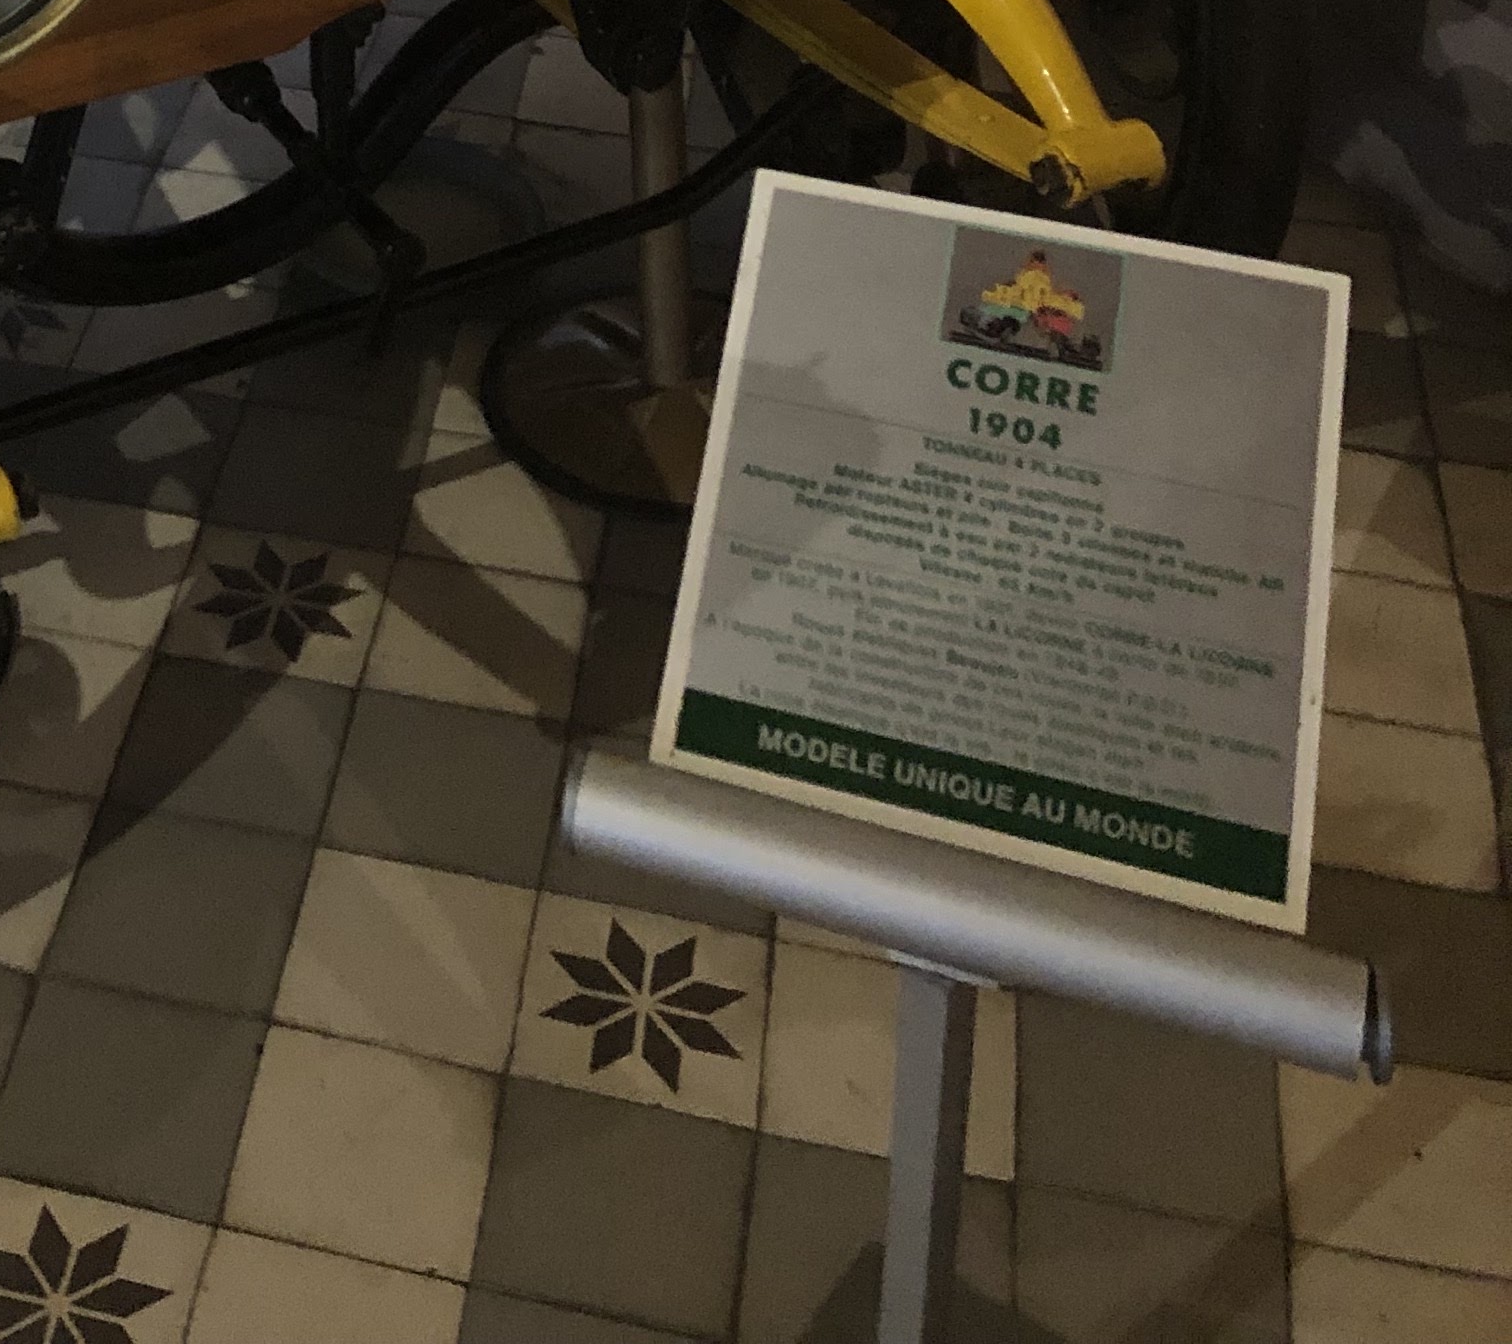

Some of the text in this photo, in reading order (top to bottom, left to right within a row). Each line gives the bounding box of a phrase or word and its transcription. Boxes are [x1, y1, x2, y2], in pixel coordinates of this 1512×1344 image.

[945, 356, 1100, 417] CORRE
[966, 407, 1063, 451] 1904
[1030, 458, 1102, 487] PLACES
[757, 724, 887, 780] MODELE
[893, 758, 1014, 813] UNIQUE
[1021, 791, 1066, 826] AU
[1073, 804, 1196, 860] MONDE
